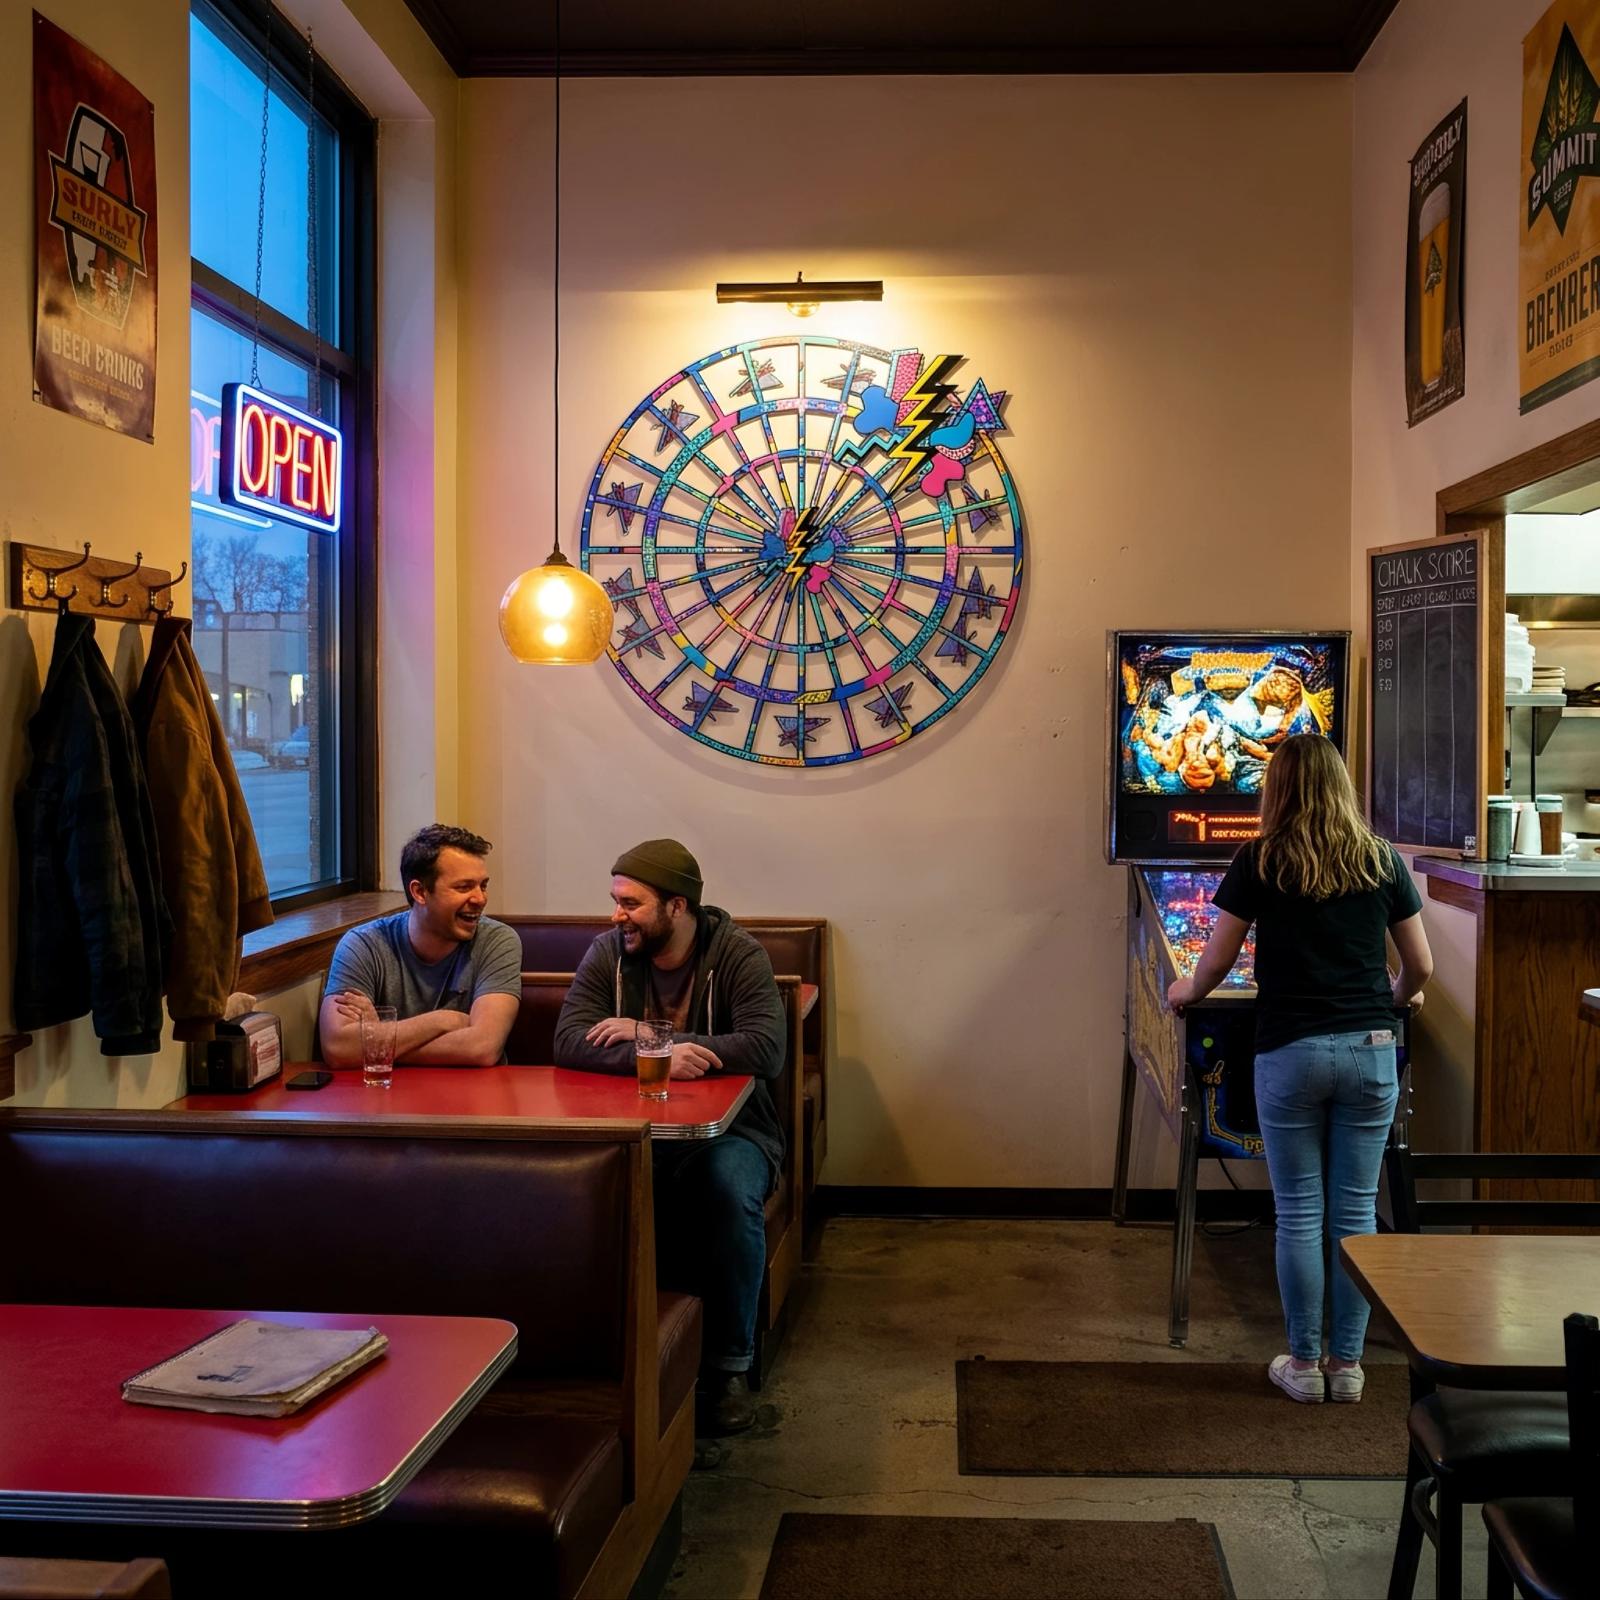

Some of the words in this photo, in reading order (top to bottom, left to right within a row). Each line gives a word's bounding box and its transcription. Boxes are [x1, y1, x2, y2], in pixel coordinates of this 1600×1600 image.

[1532, 132, 1597, 211] SUMMIT
[62, 177, 137, 239] SURLY
[52, 324, 91, 368] BEER
[241, 404, 337, 517] OPEN
[1377, 556, 1423, 588] CHALK
